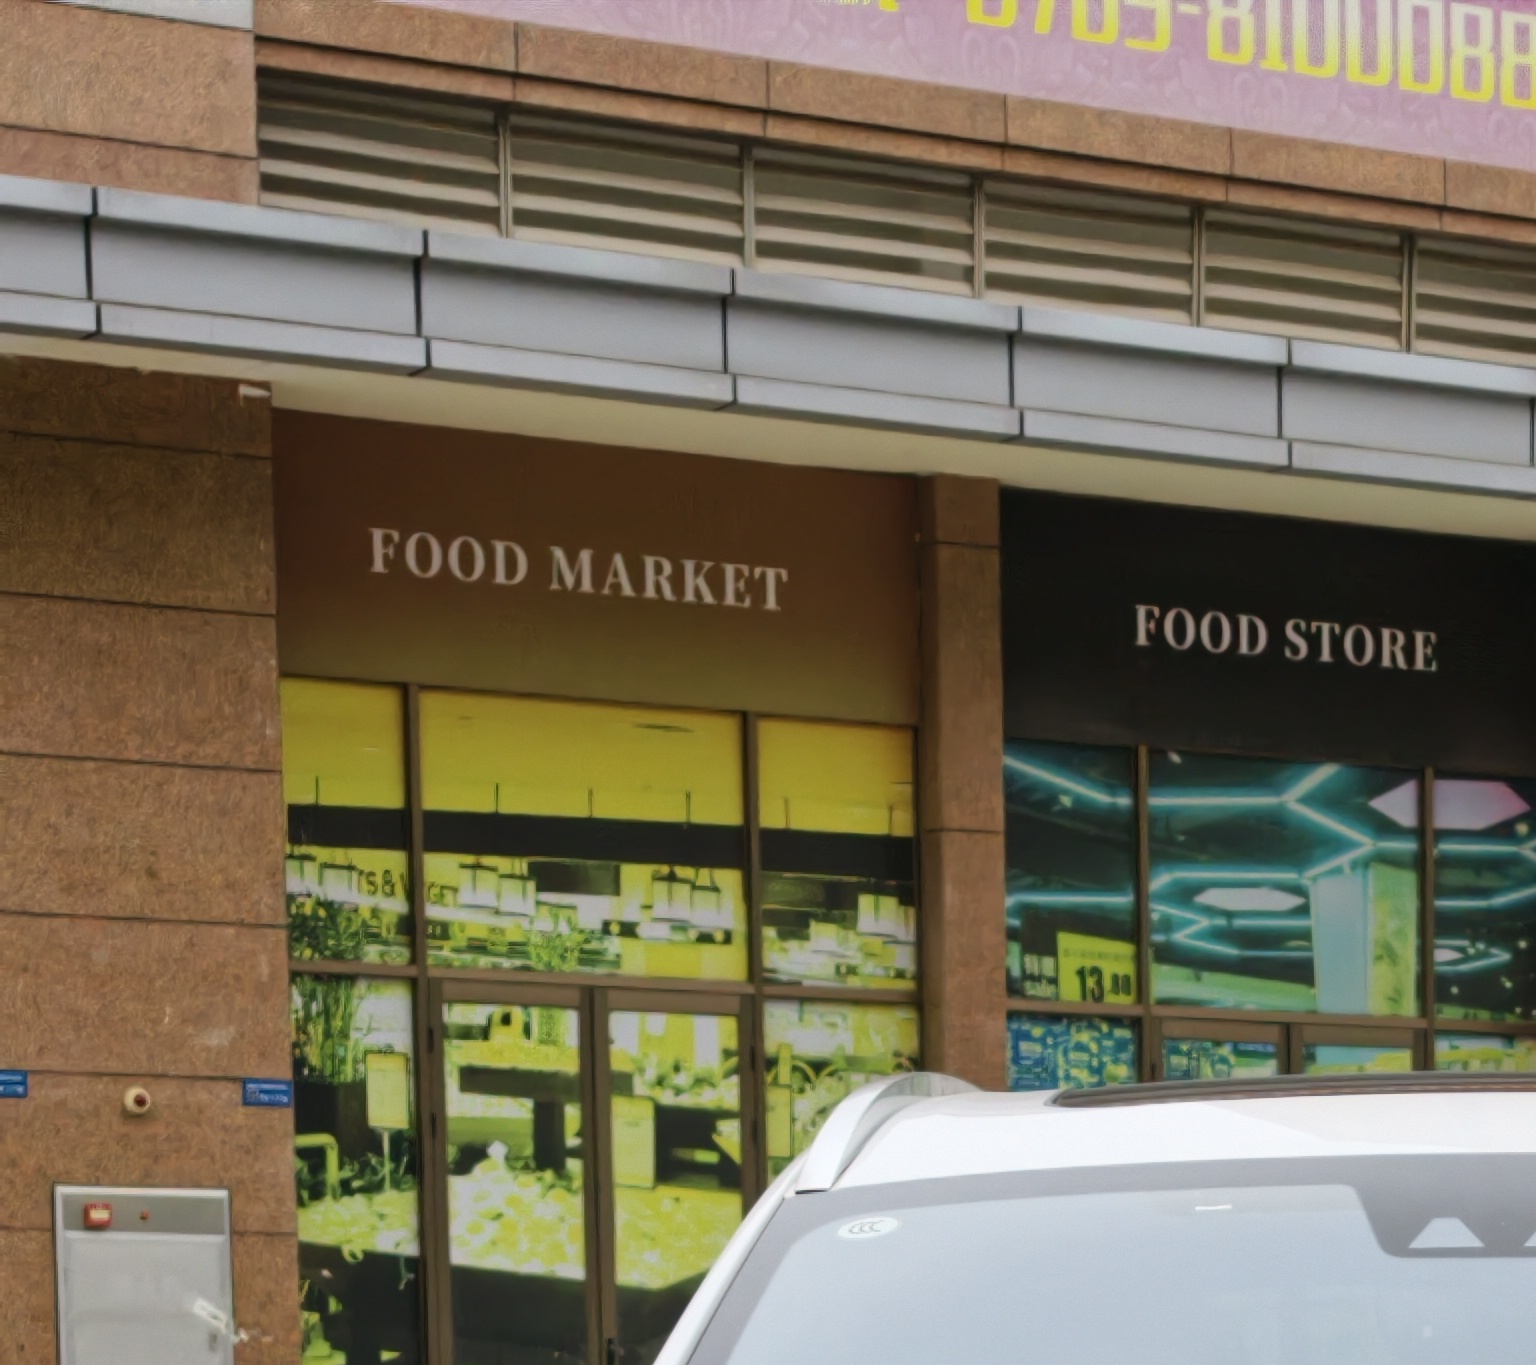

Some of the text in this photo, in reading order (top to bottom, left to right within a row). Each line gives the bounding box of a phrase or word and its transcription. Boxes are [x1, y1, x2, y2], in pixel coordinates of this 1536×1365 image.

[368, 527, 788, 611] FOOD MARKET
[1134, 603, 1438, 672] FOOD STORE
